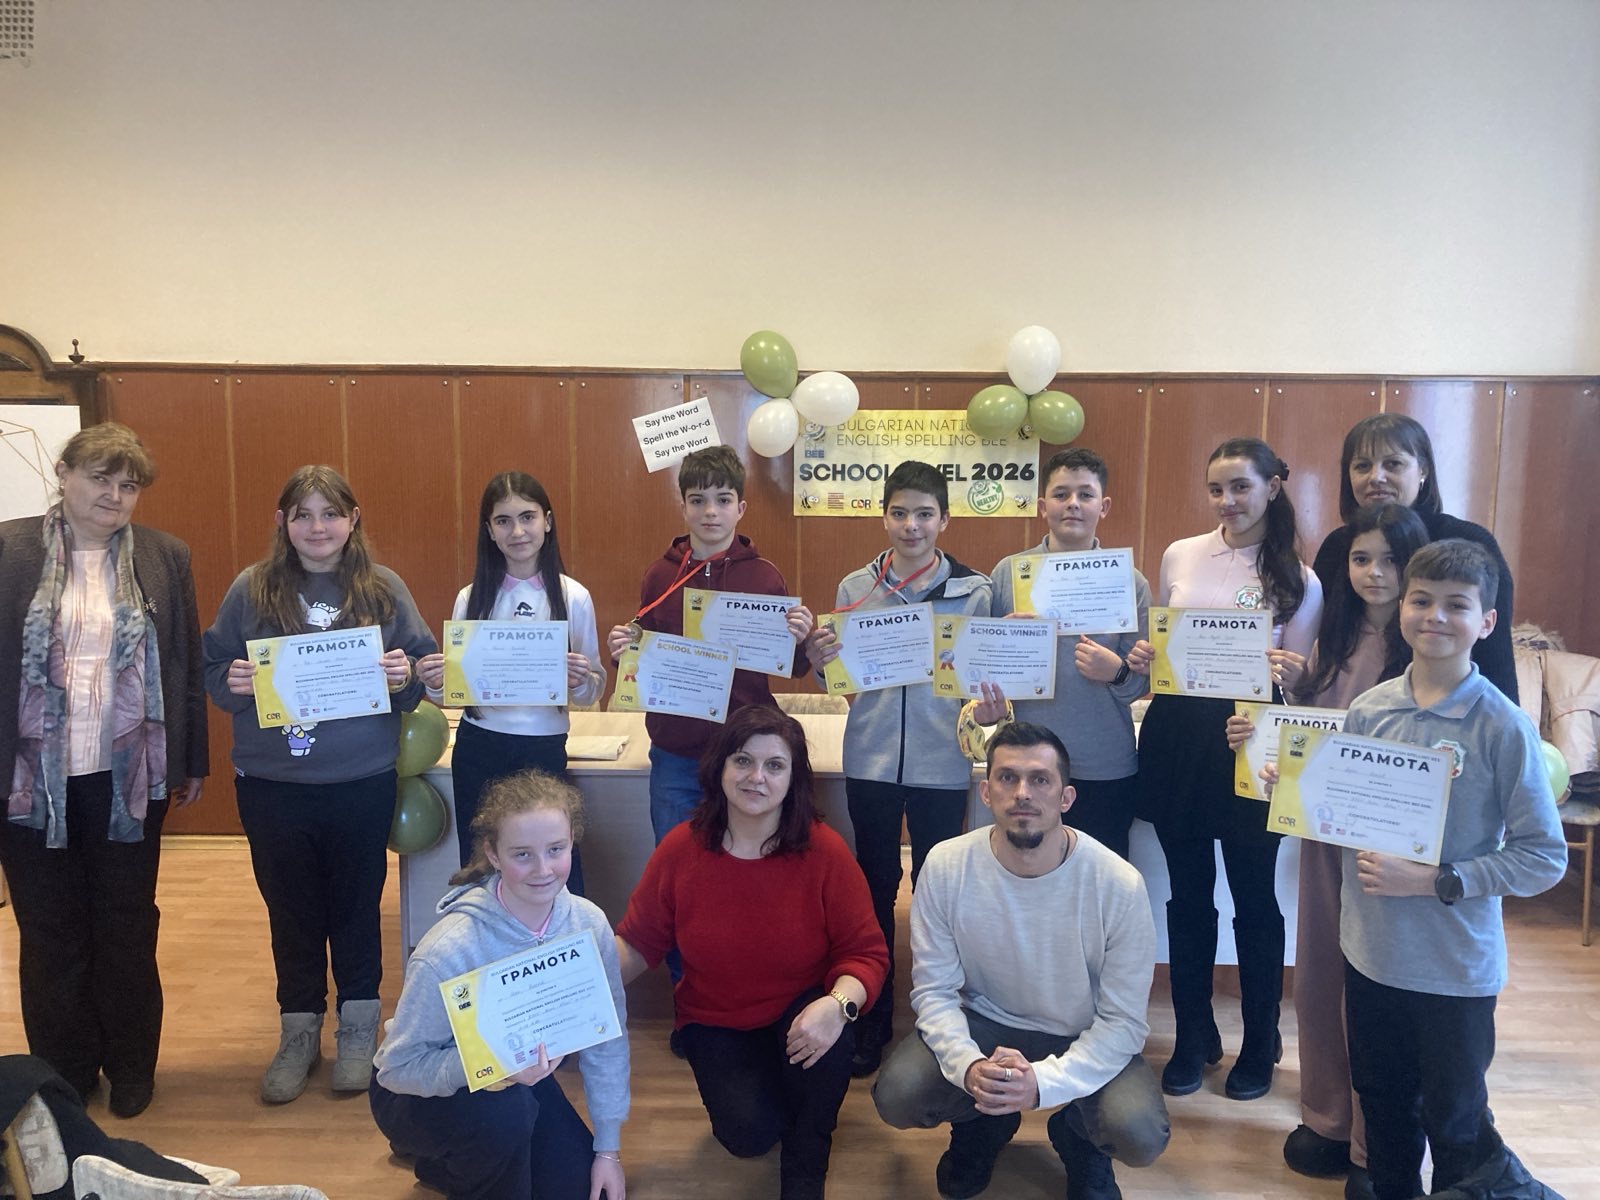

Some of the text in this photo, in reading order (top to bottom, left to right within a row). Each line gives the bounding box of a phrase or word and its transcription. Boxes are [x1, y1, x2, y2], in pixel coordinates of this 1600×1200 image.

[645, 406, 699, 428] Say the Word
[643, 419, 711, 445] Spell the W-o-r-d
[837, 419, 924, 431] BULGARIAN
[655, 436, 709, 458] Say the Word
[837, 434, 899, 446] ENGLISH
[905, 434, 976, 446] SPELLING
[971, 463, 1035, 481] 2026
[1055, 559, 1119, 571] ГРАМОТА
[726, 601, 787, 613] ГРАМОТА
[859, 614, 920, 629] ГРАМОТА
[1193, 619, 1257, 630] ГРАМОТА
[490, 631, 554, 640] ГРАМОТА
[970, 627, 1048, 637] SCHOOL WINNER
[298, 639, 367, 655] ГРАМОТА
[657, 643, 692, 655] SCHOOL
[694, 649, 729, 662] WINNER
[1341, 748, 1430, 772] ГРАМОТА
[501, 949, 580, 985] ГРАМОТА
